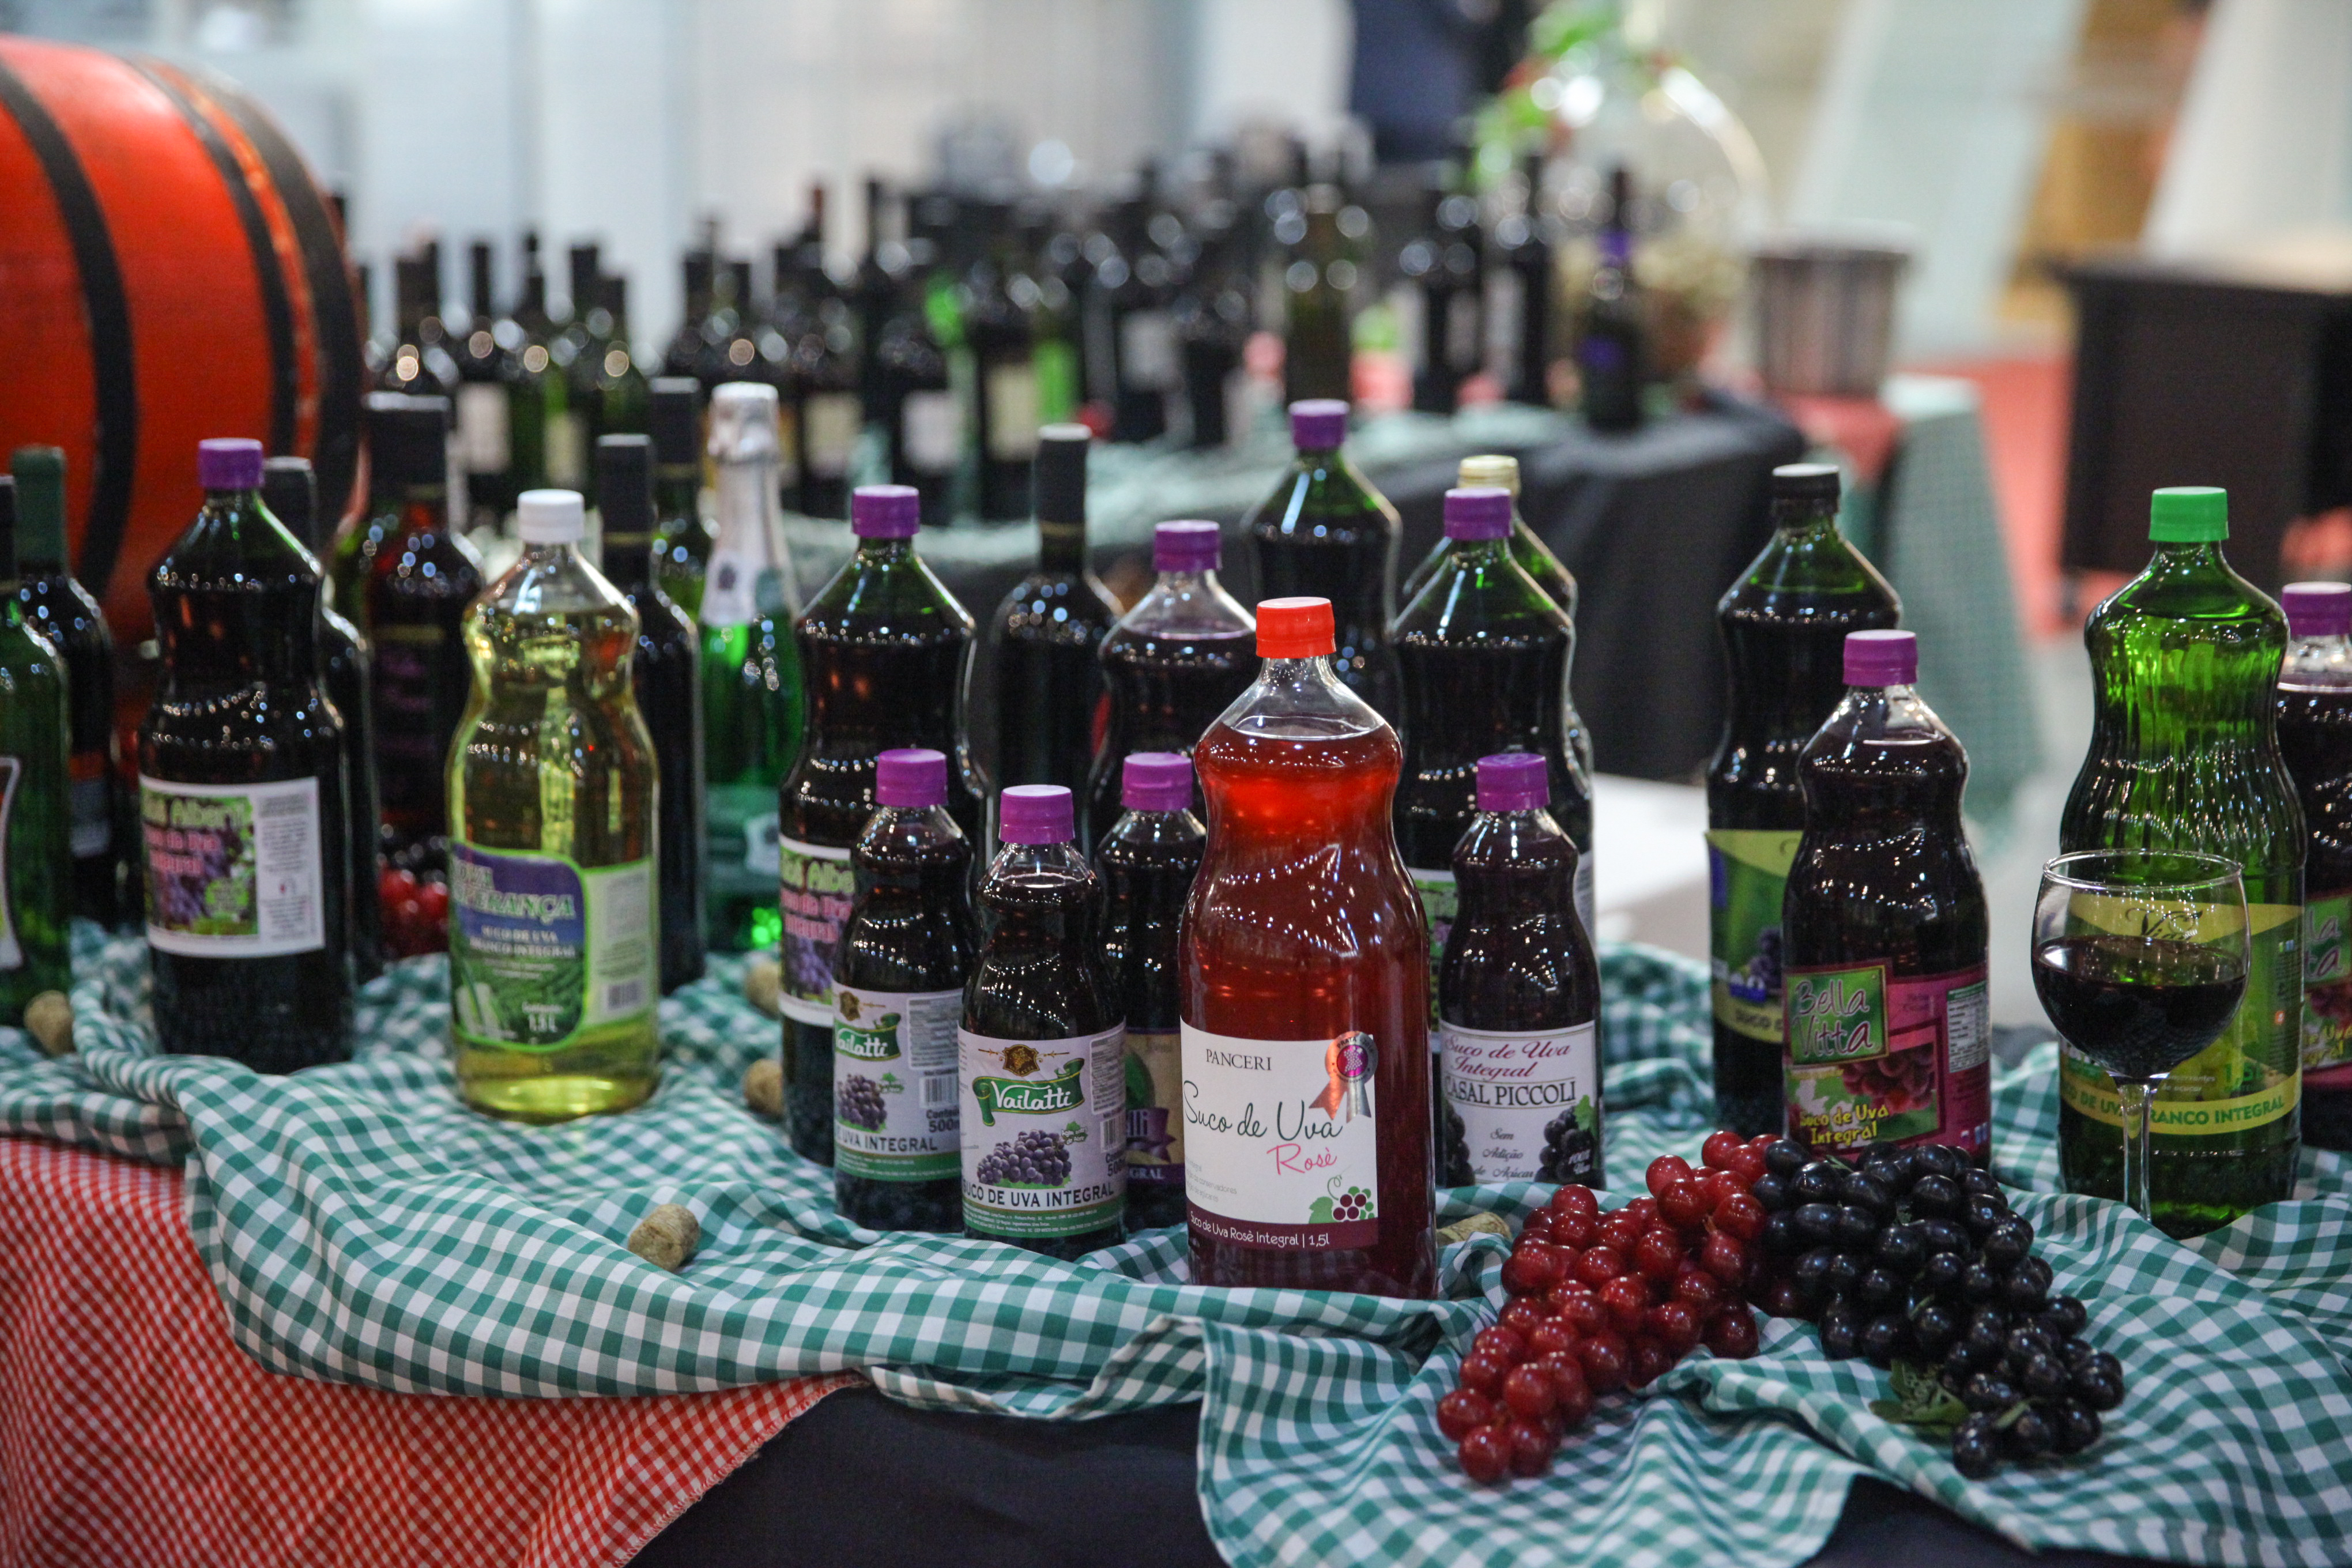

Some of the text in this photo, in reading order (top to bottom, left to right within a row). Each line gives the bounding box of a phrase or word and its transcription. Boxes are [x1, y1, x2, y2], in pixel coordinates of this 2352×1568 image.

[1793, 979, 1871, 1016] Bella
[1336, 1036, 1357, 1049] PRATA
[1443, 1035, 1571, 1060] Suco de Uva
[1789, 1015, 1874, 1057] Vitta
[1205, 1048, 1273, 1071] PANCERI
[1450, 1056, 1539, 1081] Integral
[990, 1080, 1073, 1110] Vailatti
[1444, 1075, 1576, 1106] CASAL PICCOLI
[1183, 1080, 1232, 1132] Suco
[1237, 1102, 1268, 1137] de
[1277, 1099, 1343, 1141] Uva
[1833, 1106, 1852, 1126] de
[1855, 1103, 1890, 1121] Uva
[2151, 1109, 2210, 1125] RANCO
[2215, 1095, 2285, 1124] INTEGRAL
[865, 1136, 938, 1152] INTEGRAL
[1490, 1127, 1515, 1140] Sem
[1810, 1120, 1878, 1146] Integral
[1482, 1146, 1524, 1162] Adição
[1128, 1168, 1164, 1180] GRAL
[988, 1190, 1005, 1206] DE
[1010, 1190, 1041, 1208] UVA
[1046, 1182, 1114, 1208] INTEGRAL
[1190, 1211, 1202, 1228] Suco
[1202, 1219, 1212, 1232] de
[1212, 1224, 1228, 1238] Uva
[1256, 1231, 1299, 1249] Integral
